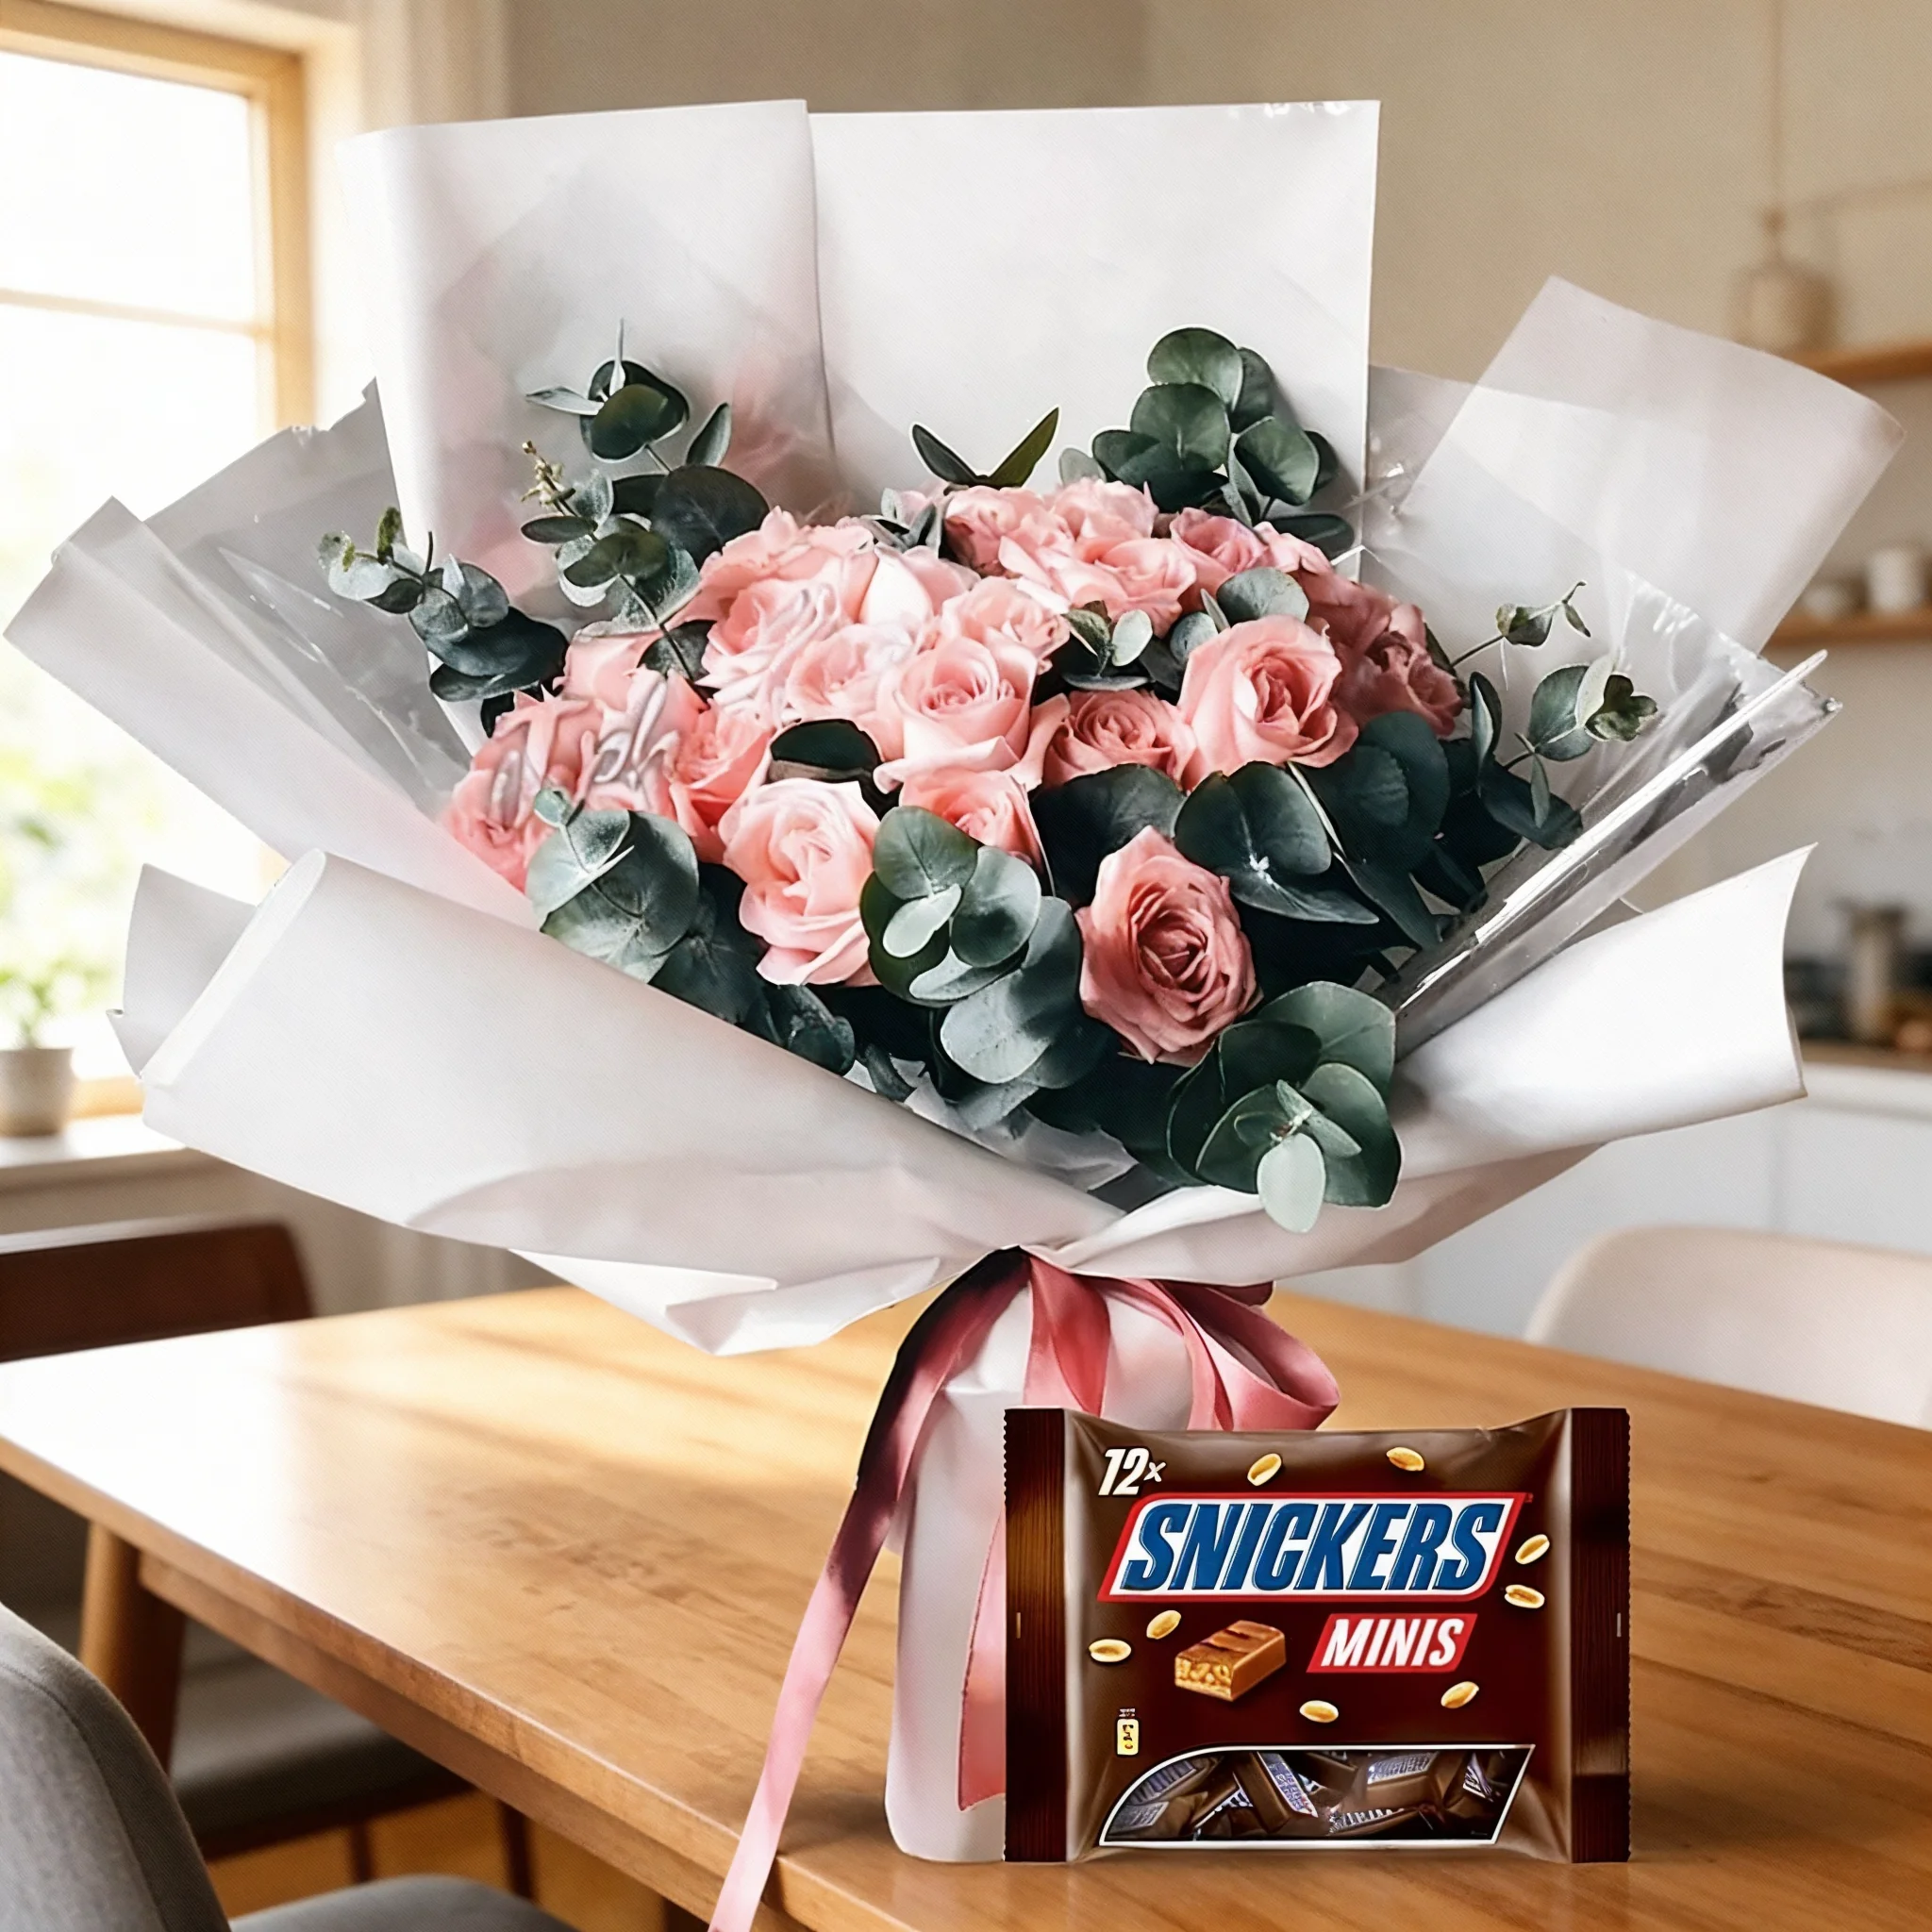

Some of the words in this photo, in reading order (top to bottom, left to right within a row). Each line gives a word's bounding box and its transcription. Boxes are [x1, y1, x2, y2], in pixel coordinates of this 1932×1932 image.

[1098, 1447, 1167, 1496] 12x
[1120, 1503, 1507, 1591] SNICKERS
[1321, 1618, 1465, 1668] MINIS
